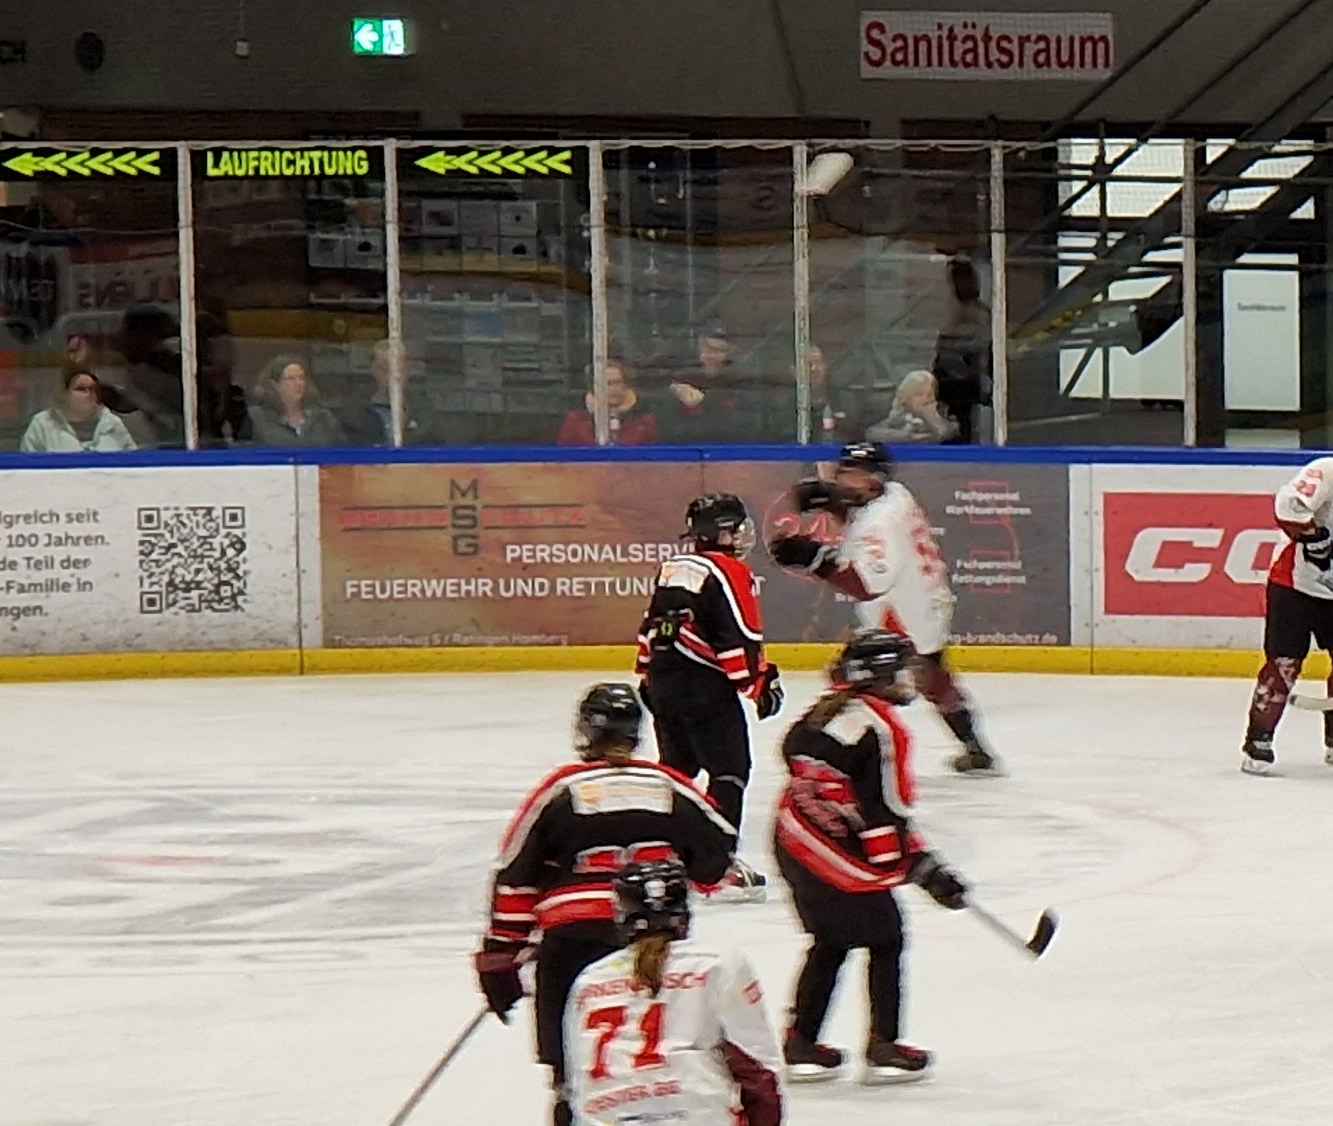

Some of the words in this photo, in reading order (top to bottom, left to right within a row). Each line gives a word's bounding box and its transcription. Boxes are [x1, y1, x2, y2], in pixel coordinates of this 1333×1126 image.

[863, 20, 1113, 70] Sanitätsraum
[206, 150, 369, 177] LAUFRICHTUNG
[65, 510, 99, 525] seit
[6, 535, 39, 548] 100
[44, 532, 110, 548] Jahren.
[24, 556, 54, 572] Teil
[60, 556, 92, 571] der
[506, 543, 696, 564] PERSONALSERVI
[77, 579, 94, 594] in
[346, 579, 495, 599] FEUERWEHR
[499, 578, 550, 597] UND
[584, 1002, 668, 1081] 71
